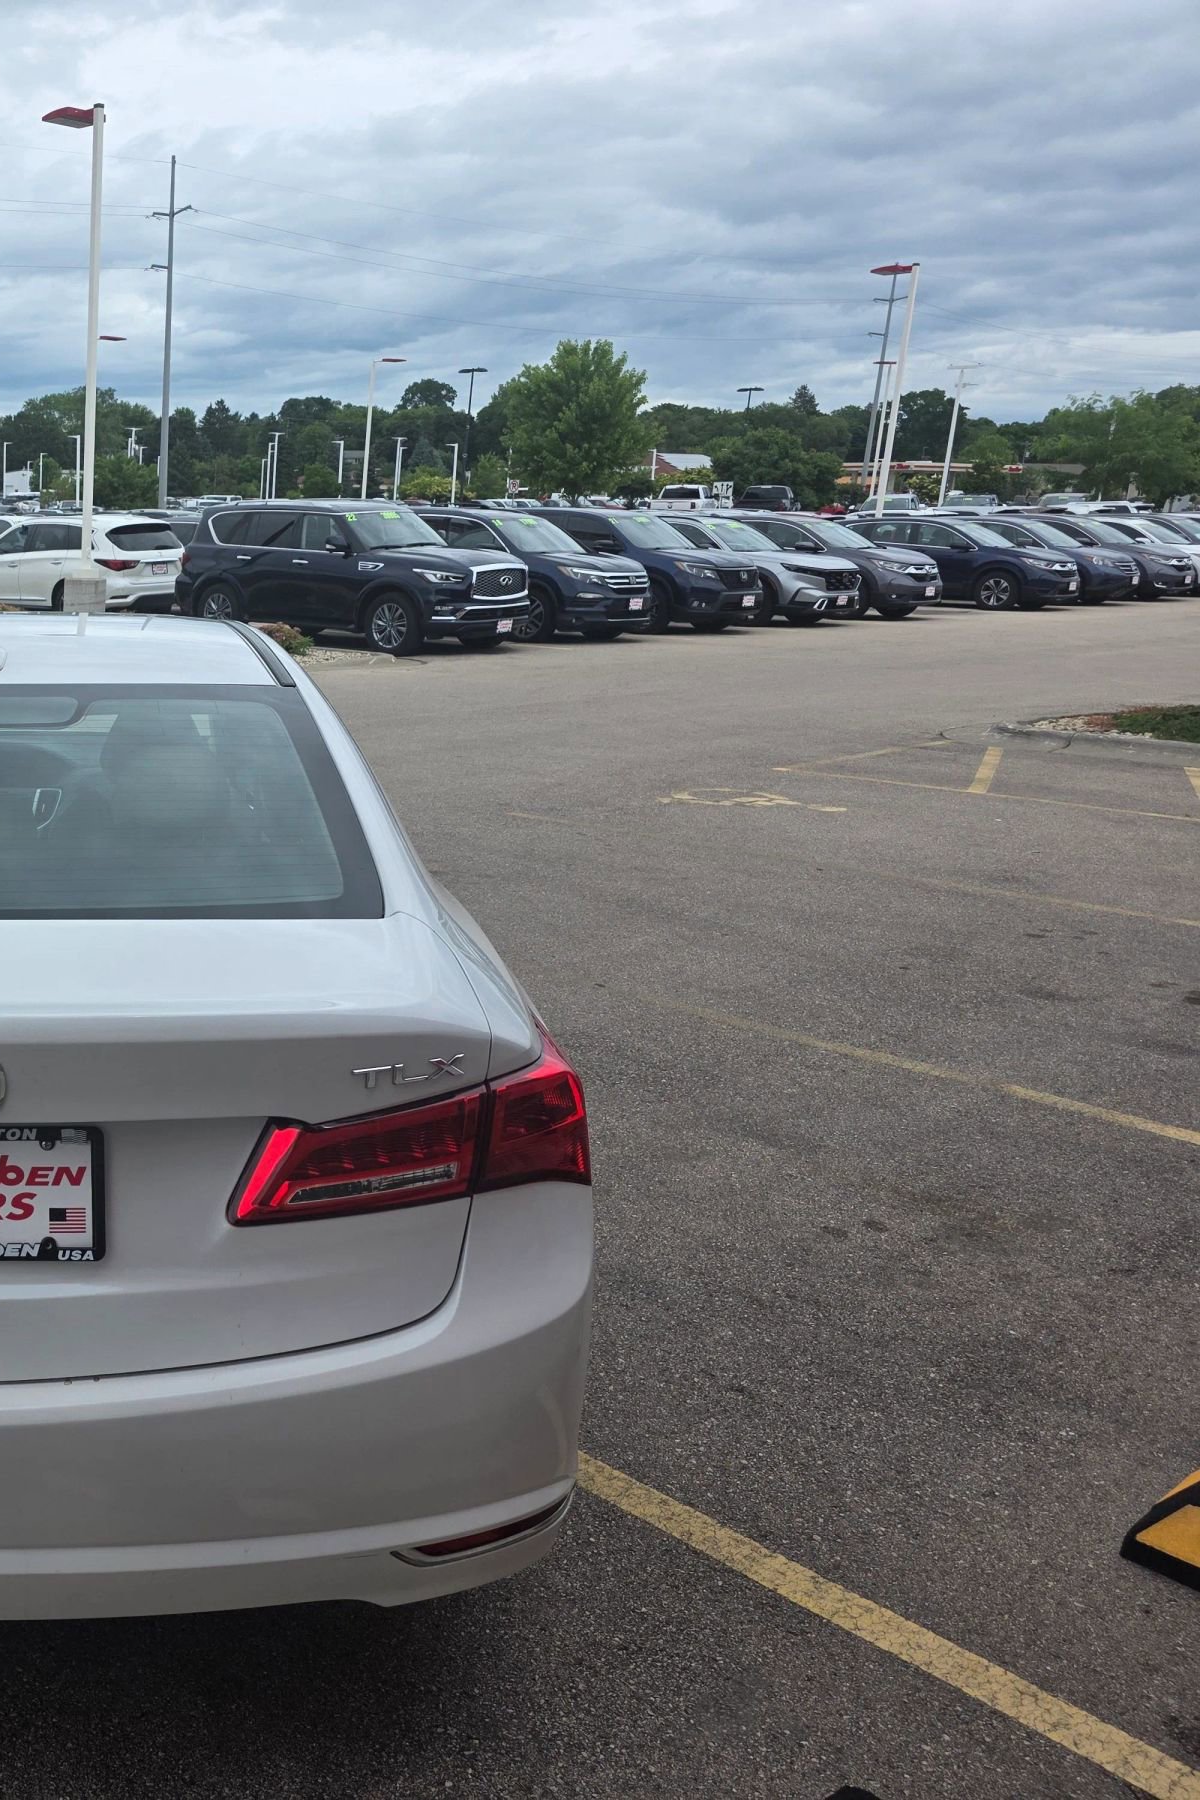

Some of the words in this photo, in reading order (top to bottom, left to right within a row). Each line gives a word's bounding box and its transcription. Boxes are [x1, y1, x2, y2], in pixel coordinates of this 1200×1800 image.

[345, 512, 358, 521] 22
[351, 1053, 465, 1089] TLX
[57, 1249, 95, 1262] USA
